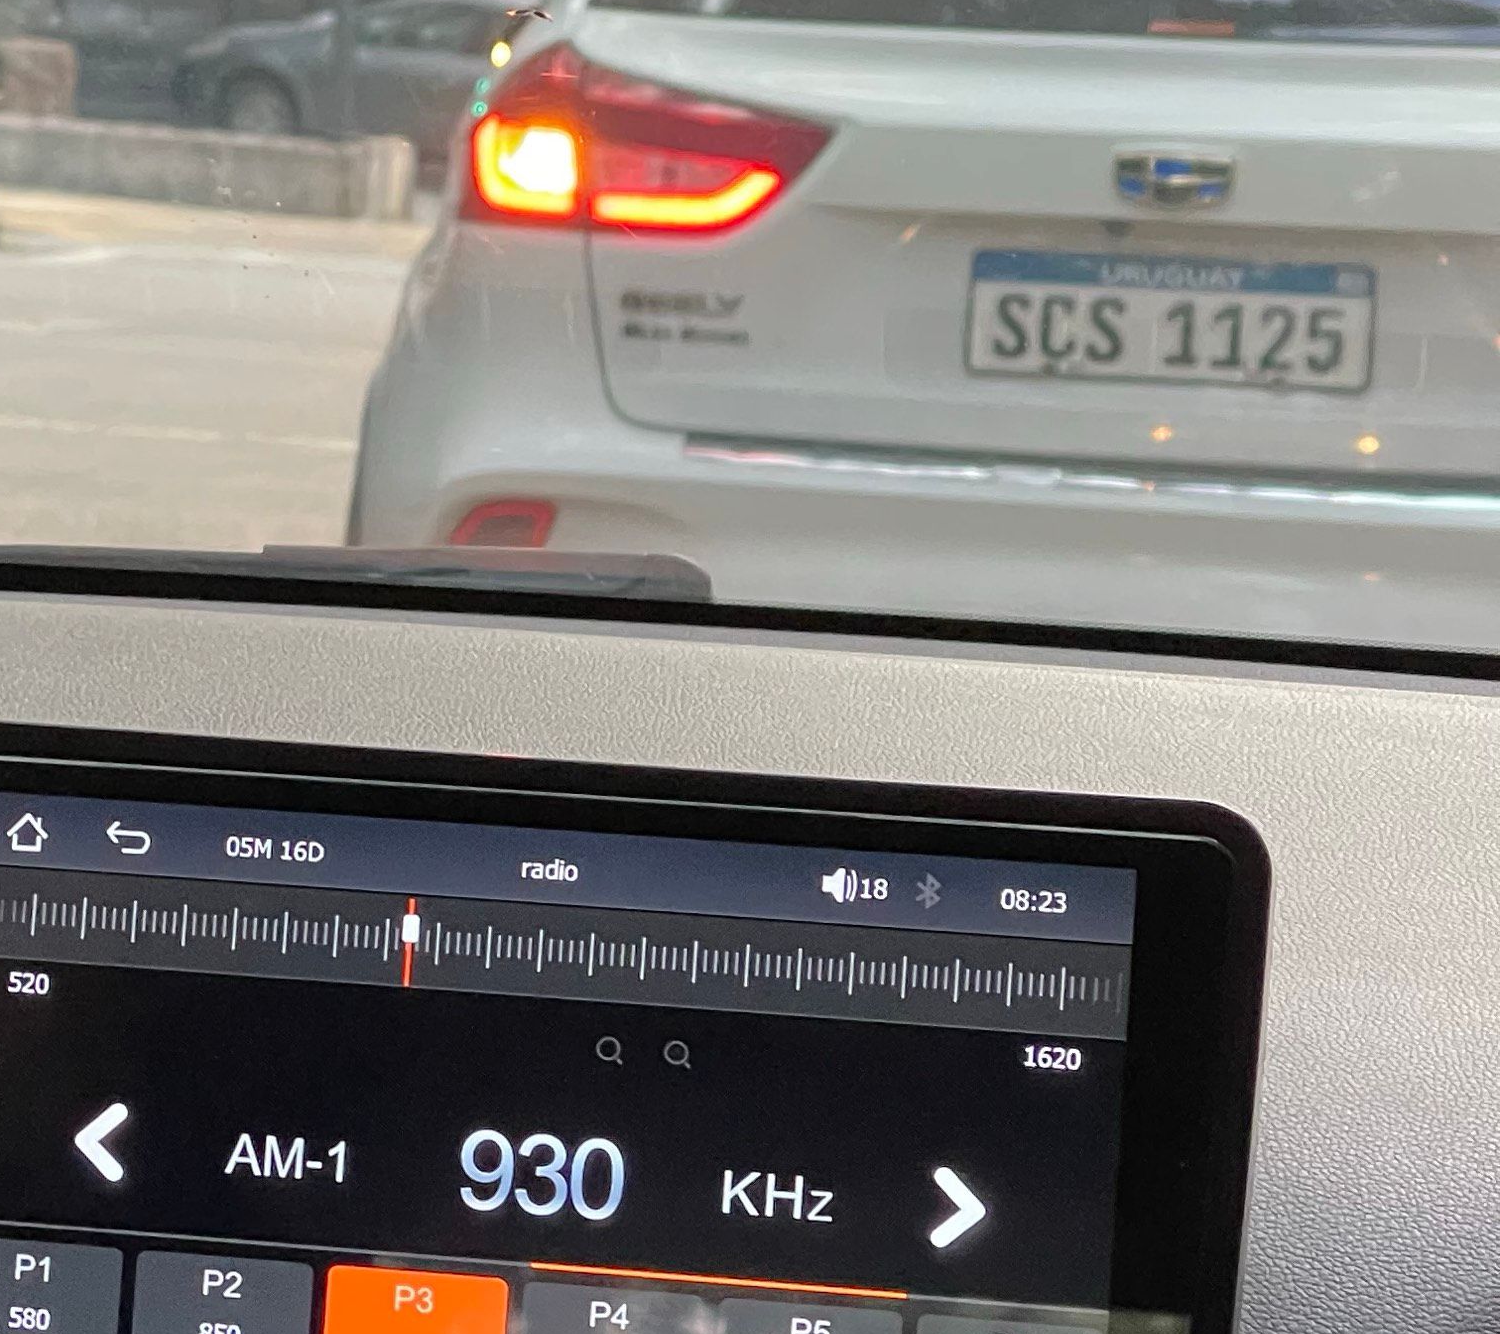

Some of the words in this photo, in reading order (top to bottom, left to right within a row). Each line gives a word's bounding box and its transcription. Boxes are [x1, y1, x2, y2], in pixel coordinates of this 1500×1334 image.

[991, 293, 1126, 363] SCS
[1163, 301, 1347, 372] 1125
[225, 835, 273, 859] 05M
[280, 839, 325, 863] 16D
[520, 858, 579, 883] radio
[859, 876, 889, 901] 18
[1000, 888, 1068, 914] 08:23
[7, 971, 51, 996] 520
[1022, 1045, 1083, 1072] 1620
[224, 1132, 348, 1184] AM-1
[459, 1128, 626, 1221] 930
[721, 1169, 835, 1223] KHz
[13, 1254, 53, 1283] P1
[202, 1269, 243, 1300] P2
[393, 1285, 434, 1314] P3
[7, 1306, 51, 1332] 580
[588, 1301, 630, 1331] P4
